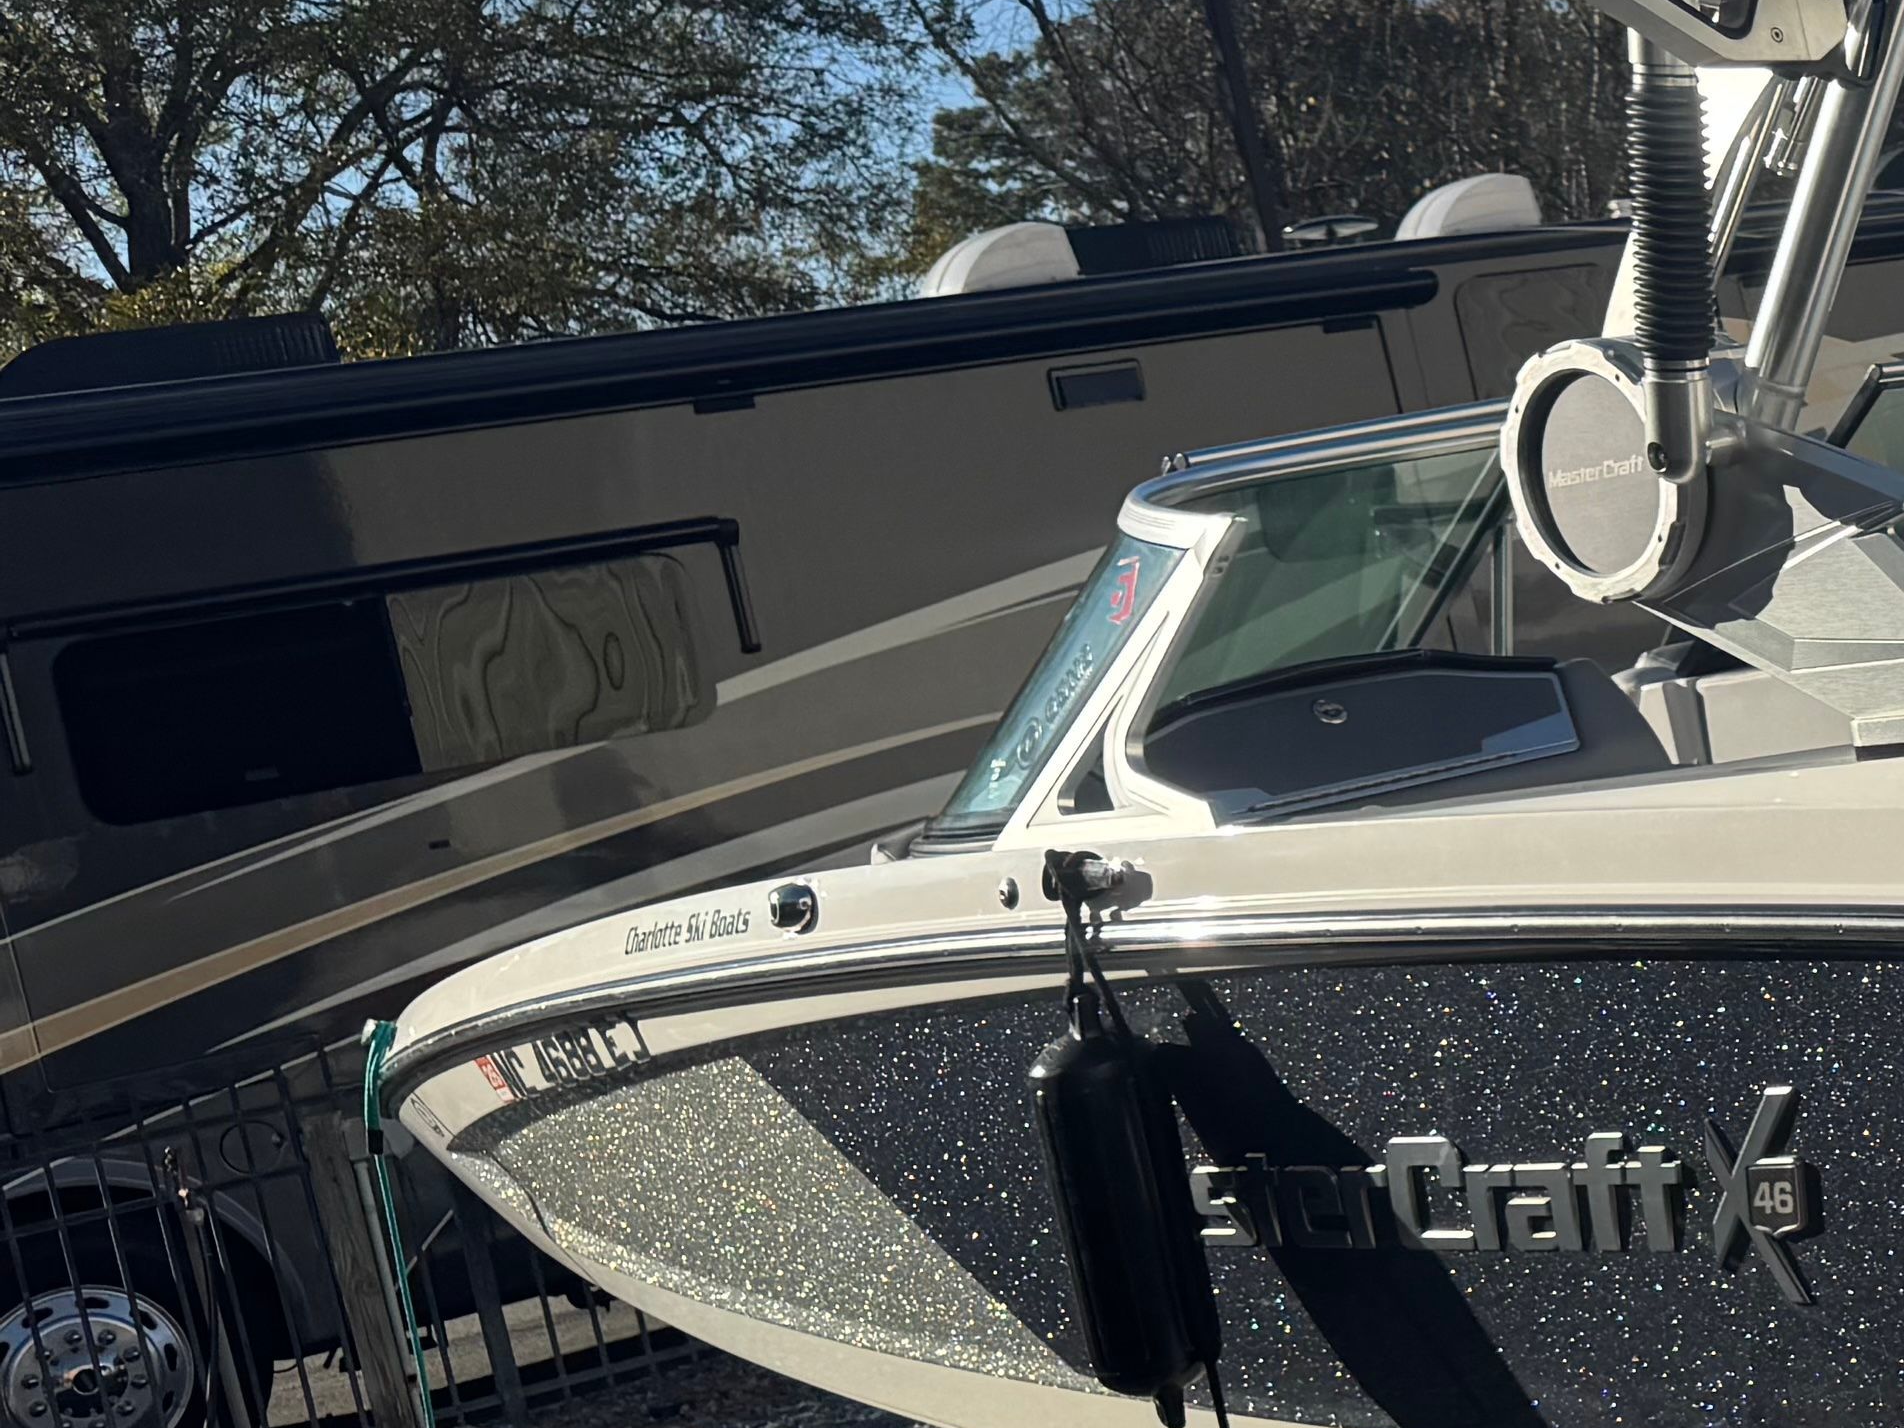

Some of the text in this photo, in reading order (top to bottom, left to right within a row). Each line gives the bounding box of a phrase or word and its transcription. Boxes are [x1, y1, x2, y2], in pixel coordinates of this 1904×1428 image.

[1548, 454, 1644, 489] MasterCraft
[625, 908, 751, 955] Charlotte Ski Boats
[1189, 1132, 1683, 1252] sterCraft
[1753, 1180, 1795, 1215] 46
